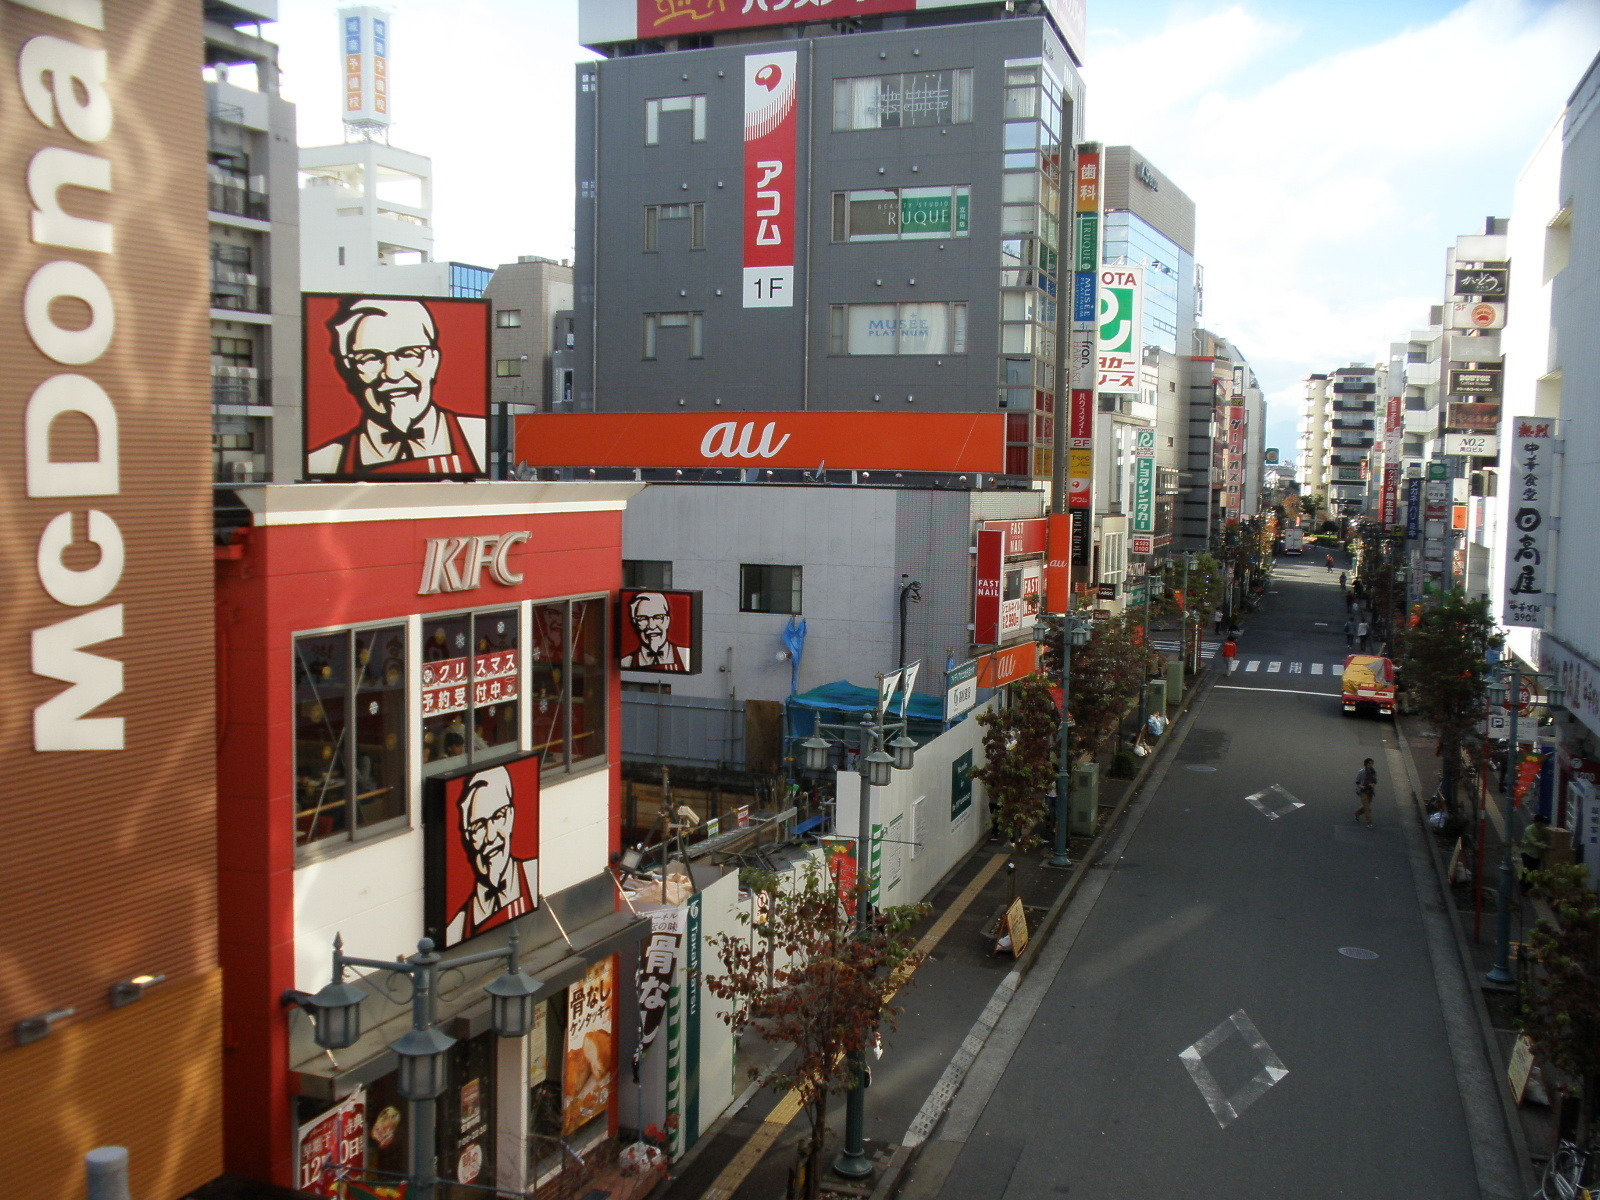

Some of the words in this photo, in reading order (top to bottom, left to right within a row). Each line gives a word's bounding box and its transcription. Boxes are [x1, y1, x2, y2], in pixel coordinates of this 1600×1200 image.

[1081, 164, 1096, 200] 歯科
[756, 160, 783, 246] アコム
[882, 209, 949, 226] RUQUE
[1083, 221, 1091, 260] TRUQUE
[754, 278, 784, 299] 1F
[1455, 304, 1467, 312] 3F
[701, 420, 791, 459] au
[1517, 421, 1550, 439] 熱烈
[1523, 443, 1540, 502] 中華食堂
[1137, 459, 1150, 529] トヨタレンタカー
[1011, 522, 1024, 535] FAST
[1010, 540, 1023, 552] NAIL
[1509, 507, 1542, 595] 日高屋
[418, 531, 532, 594] KFC
[1050, 559, 1068, 568] au
[978, 579, 999, 588] FAST
[978, 588, 999, 596] NAIL
[1024, 577, 1038, 594] FAST
[439, 654, 516, 682] クリスマス
[998, 653, 1016, 680] au
[422, 681, 501, 712] 予約受付中
[570, 979, 612, 1020] 骨なし
[640, 934, 678, 1044] 骨なし
[569, 1005, 612, 1036] ケンタッキー
